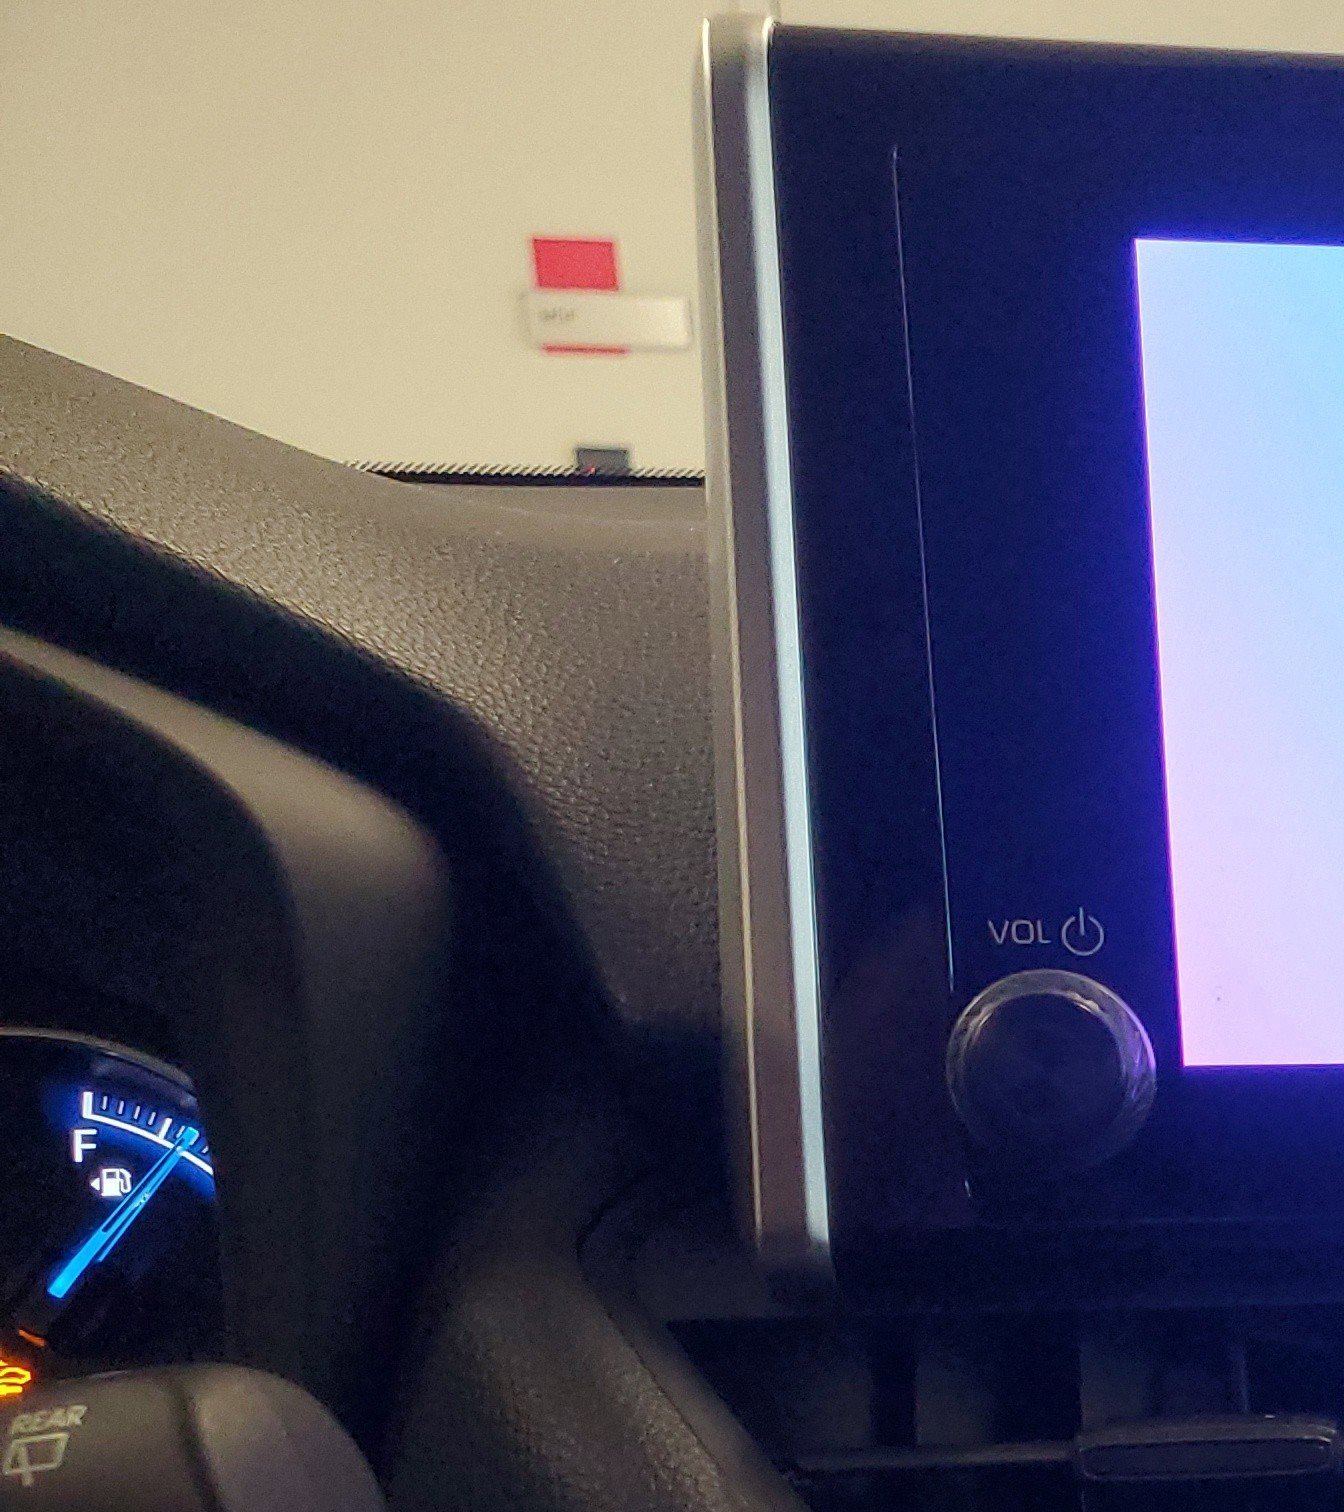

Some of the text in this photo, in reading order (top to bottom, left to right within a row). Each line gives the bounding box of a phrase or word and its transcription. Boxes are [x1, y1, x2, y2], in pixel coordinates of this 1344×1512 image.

[987, 919, 1051, 944] VOL
[73, 1129, 98, 1163] F
[10, 1404, 88, 1435] REAR
